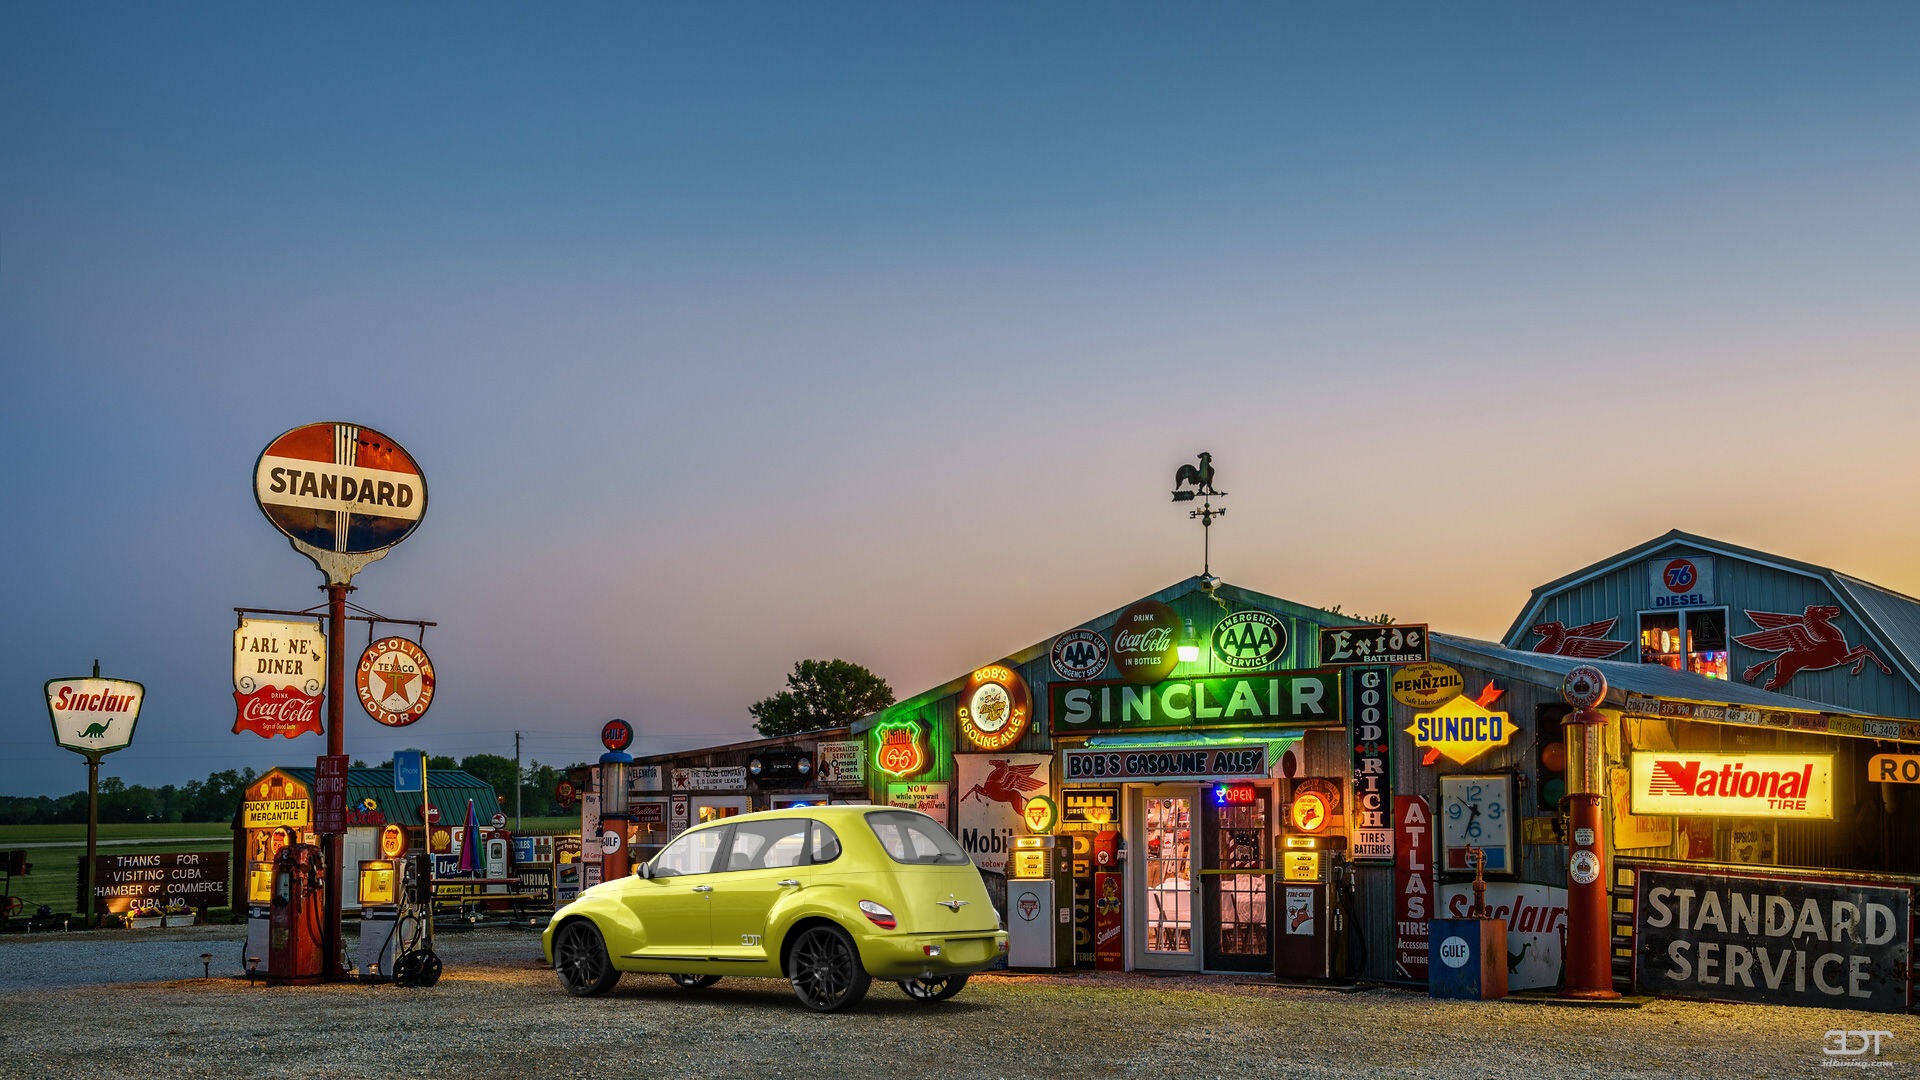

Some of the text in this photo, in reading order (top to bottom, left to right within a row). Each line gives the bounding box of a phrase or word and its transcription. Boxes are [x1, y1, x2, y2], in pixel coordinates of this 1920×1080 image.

[269, 467, 414, 508] STANDARD
[1668, 565, 1691, 586] 76
[1656, 593, 1707, 607] DIESEL
[1134, 614, 1154, 622] DRINK
[1220, 613, 1277, 632] EMERGENCY
[1080, 632, 1094, 641] AUTO
[1115, 627, 1173, 653] Coca-Cola
[1223, 623, 1274, 656] AAA
[1330, 628, 1420, 661] Exide
[361, 640, 429, 675] GASOLINE
[1065, 642, 1096, 668] AAA
[1134, 657, 1161, 666] BOTTLES
[1226, 655, 1268, 667] SERVICE
[1363, 653, 1422, 662] BATTERIES
[257, 659, 303, 675] DINER
[378, 663, 414, 673] TEXACO
[974, 667, 1008, 681] BOB'S
[1055, 657, 1105, 678] EMERGENCY SERVICE
[1394, 675, 1462, 692] PENNZOIL
[55, 685, 136, 713] Sinclair
[360, 686, 432, 724] MOTOR OIL
[1064, 677, 1325, 725] SINCLAIR
[1405, 696, 1450, 706] Safe Lubrication
[243, 697, 315, 722] Coca-Cola
[1727, 709, 1740, 720] 489
[604, 728, 625, 741] GULF
[959, 708, 1026, 747] GASOLINE ALLEY
[1417, 716, 1503, 742] SUNOCO
[1864, 722, 1899, 736] DC 3402
[886, 749, 912, 768] 66
[1070, 751, 1263, 776] BOB'S GASOLINE ALLEY
[1648, 760, 1814, 799] National
[907, 785, 928, 793] NOW
[1226, 788, 1253, 801] OPEN
[1466, 785, 1482, 801] 12
[244, 800, 306, 811] PUCKY HUDDLE
[1449, 802, 1501, 820] 9 3
[1767, 800, 1807, 811] TIRE
[250, 811, 299, 821] MERCANTILE
[1360, 832, 1386, 843] TIRES
[1468, 821, 1482, 838] 6
[602, 836, 619, 847] GULF
[1354, 845, 1391, 855] BATTERIES
[117, 854, 199, 867] THANKS FOR
[1404, 803, 1427, 920] ATLAS
[113, 868, 202, 882] VISITING CUBA
[148, 885, 161, 893] OF
[167, 881, 224, 894] COMMERCE
[561, 892, 576, 900] VISA
[1647, 886, 1897, 945] STANDARD
[1442, 944, 1466, 958] GULF
[1665, 939, 1873, 998] SERVICE
